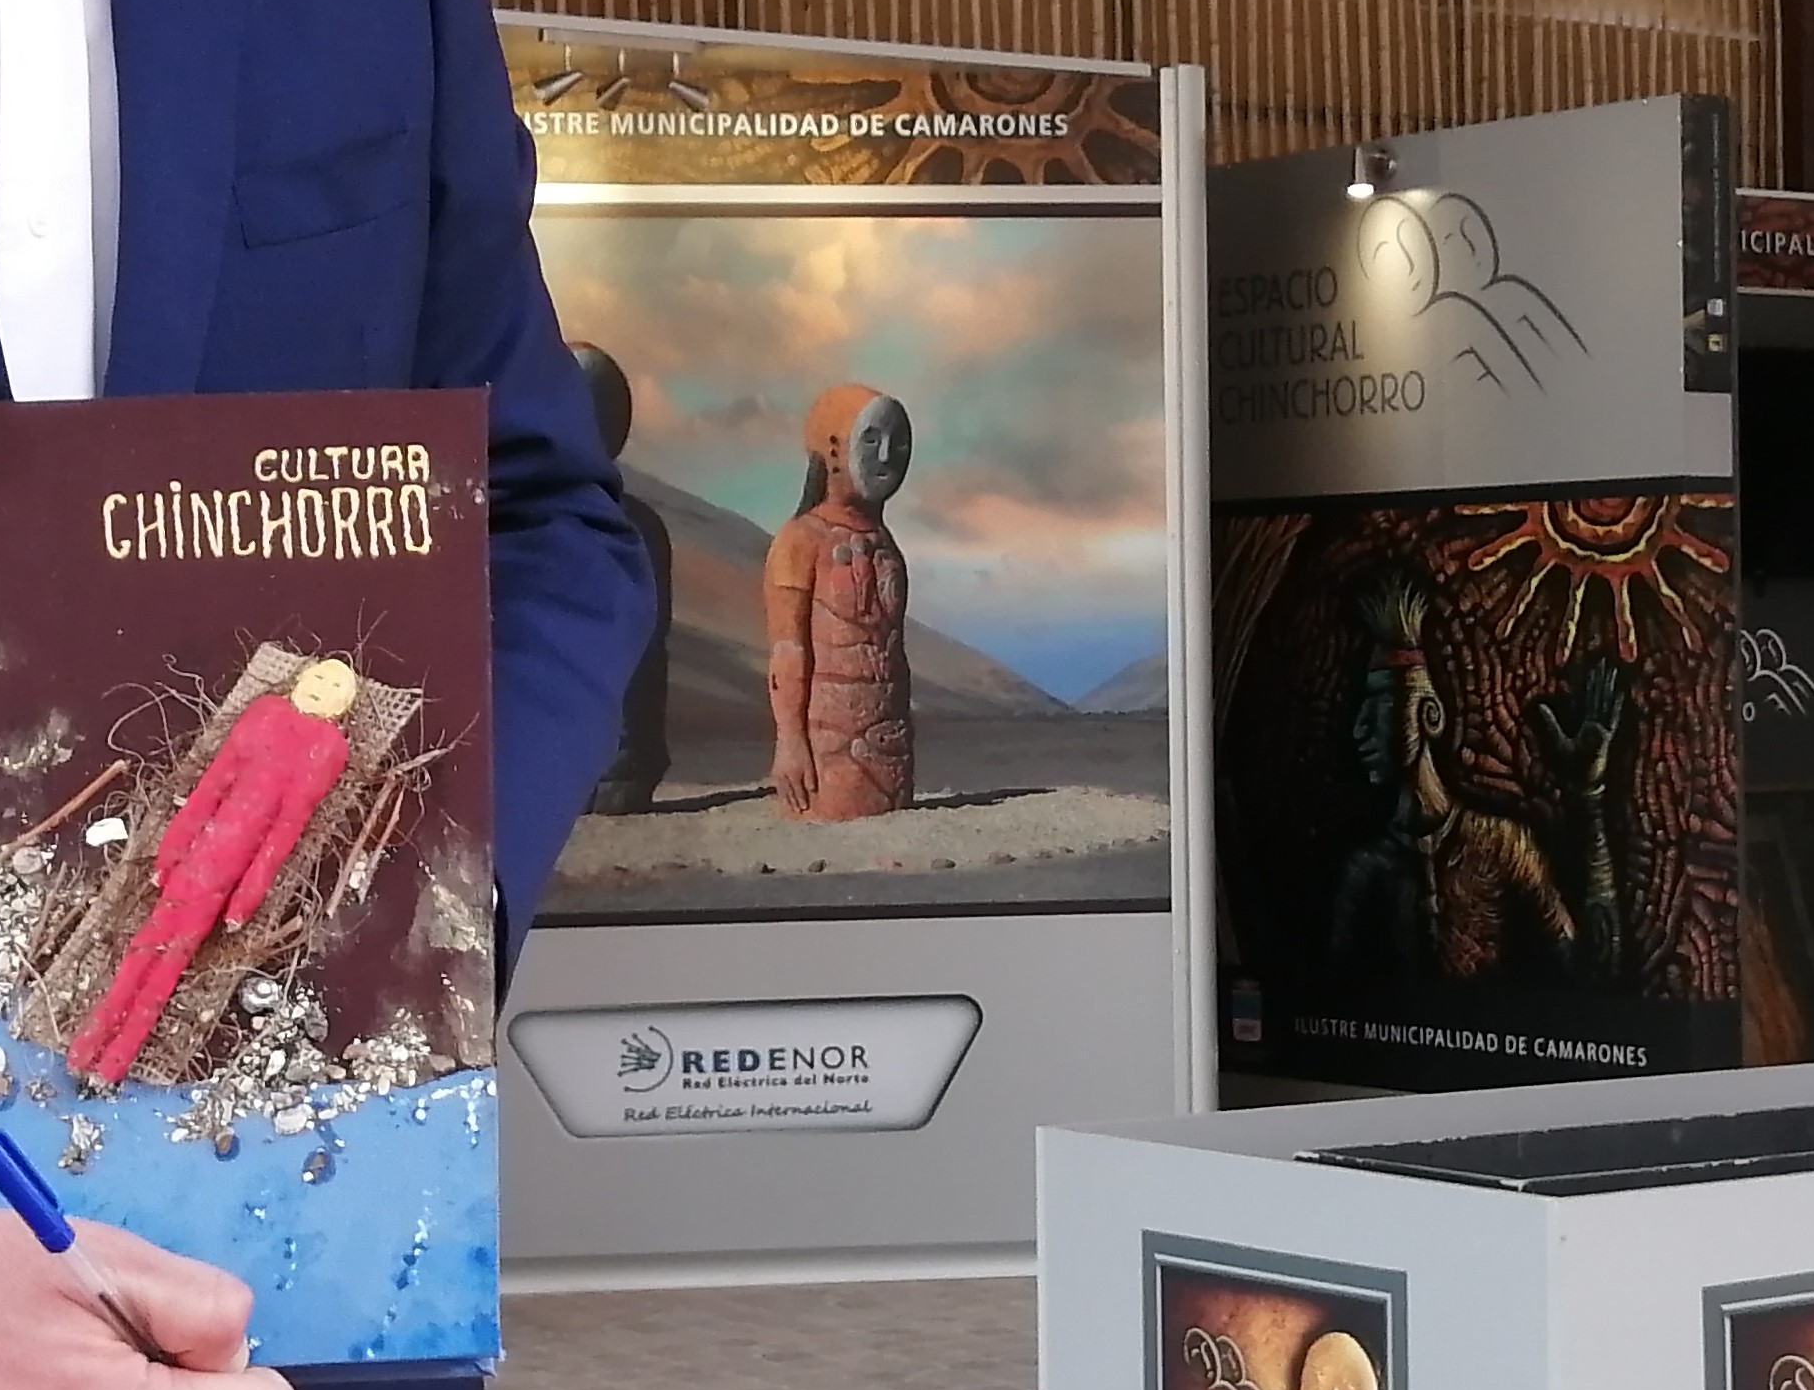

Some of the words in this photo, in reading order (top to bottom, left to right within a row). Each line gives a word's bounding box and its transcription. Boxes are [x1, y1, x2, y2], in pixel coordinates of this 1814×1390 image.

[611, 113, 840, 137] MUNICIPALIDAD
[849, 113, 886, 137] DE
[895, 113, 1069, 138] CAMARONES
[1218, 266, 1339, 318] ESPACIO
[1218, 319, 1365, 371] CULTURAL
[1218, 370, 1426, 425] CHINCHORRO
[254, 444, 430, 484] CULTURA
[682, 1045, 869, 1074] REDENOR
[1294, 1017, 1358, 1040] ILUSTRE
[1363, 1021, 1498, 1054] MUNICIPALIDAD
[1505, 1033, 1529, 1056] DE
[1533, 1037, 1649, 1069] CAMARONES
